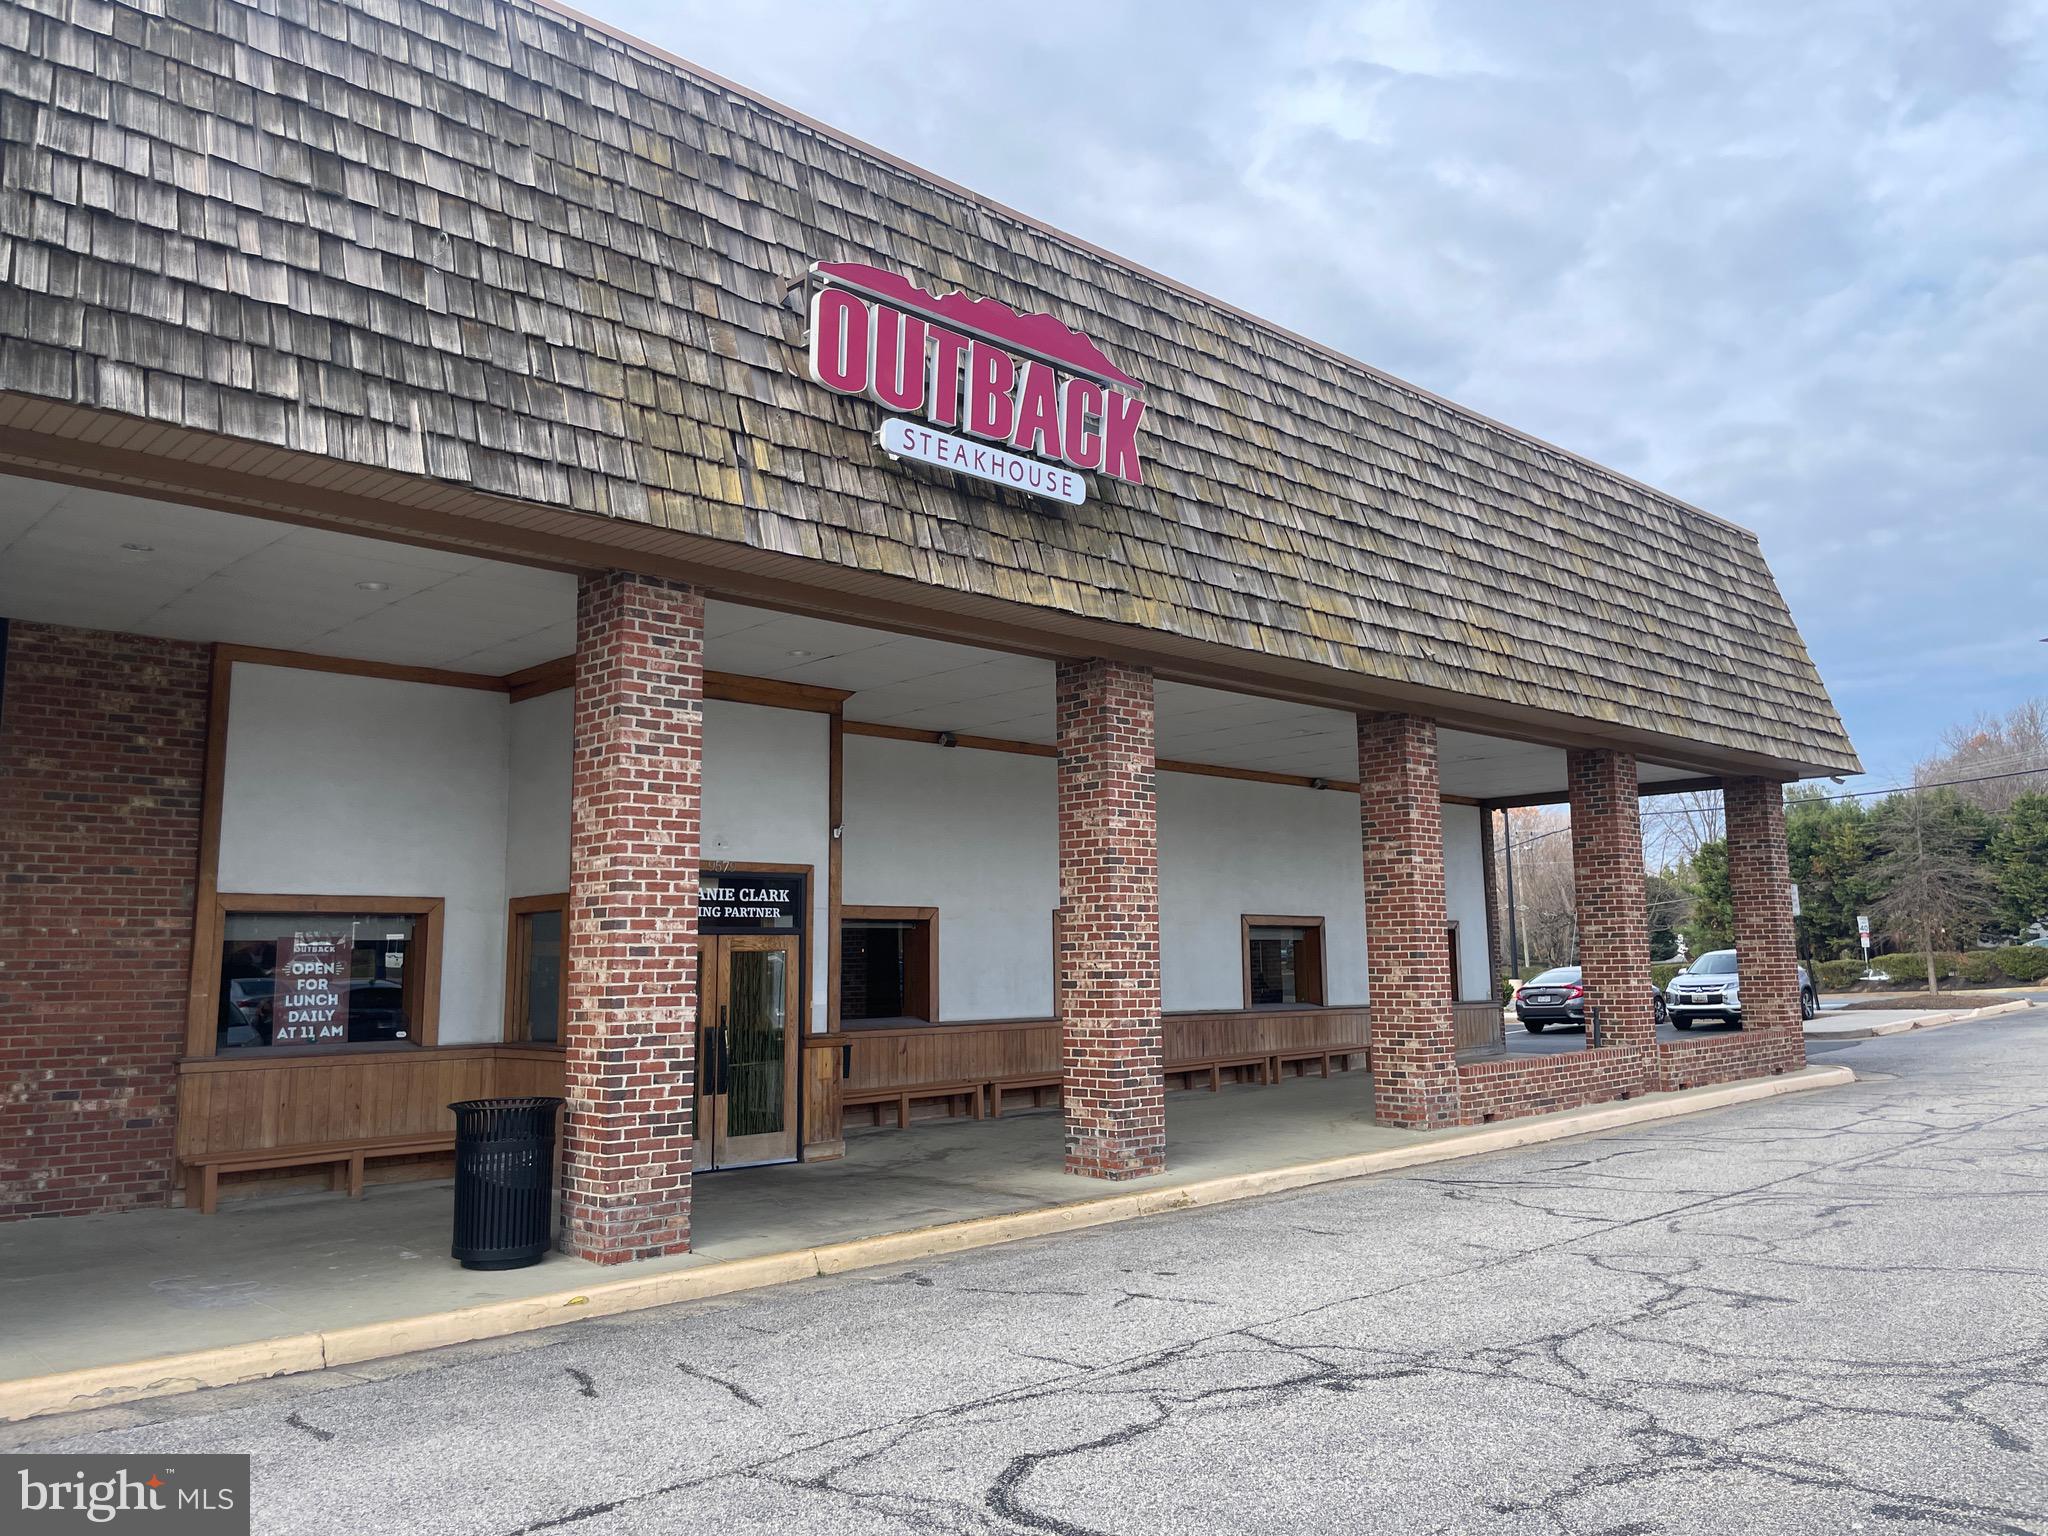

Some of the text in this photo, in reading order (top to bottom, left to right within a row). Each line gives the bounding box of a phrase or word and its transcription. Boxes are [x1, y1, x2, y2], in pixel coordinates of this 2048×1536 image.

[809, 287, 1146, 485] OUTBACK
[903, 427, 1073, 497] STEAKHOUSE
[739, 888, 790, 902] CLARK
[724, 906, 781, 918] PARTNER
[294, 945, 336, 953] OUTBACK
[292, 962, 335, 975] OPEN
[297, 978, 329, 991] FOR
[285, 993, 339, 1007] LUNCH
[288, 1009, 336, 1023] DAILY
[276, 1024, 344, 1039] AT 11 AM
